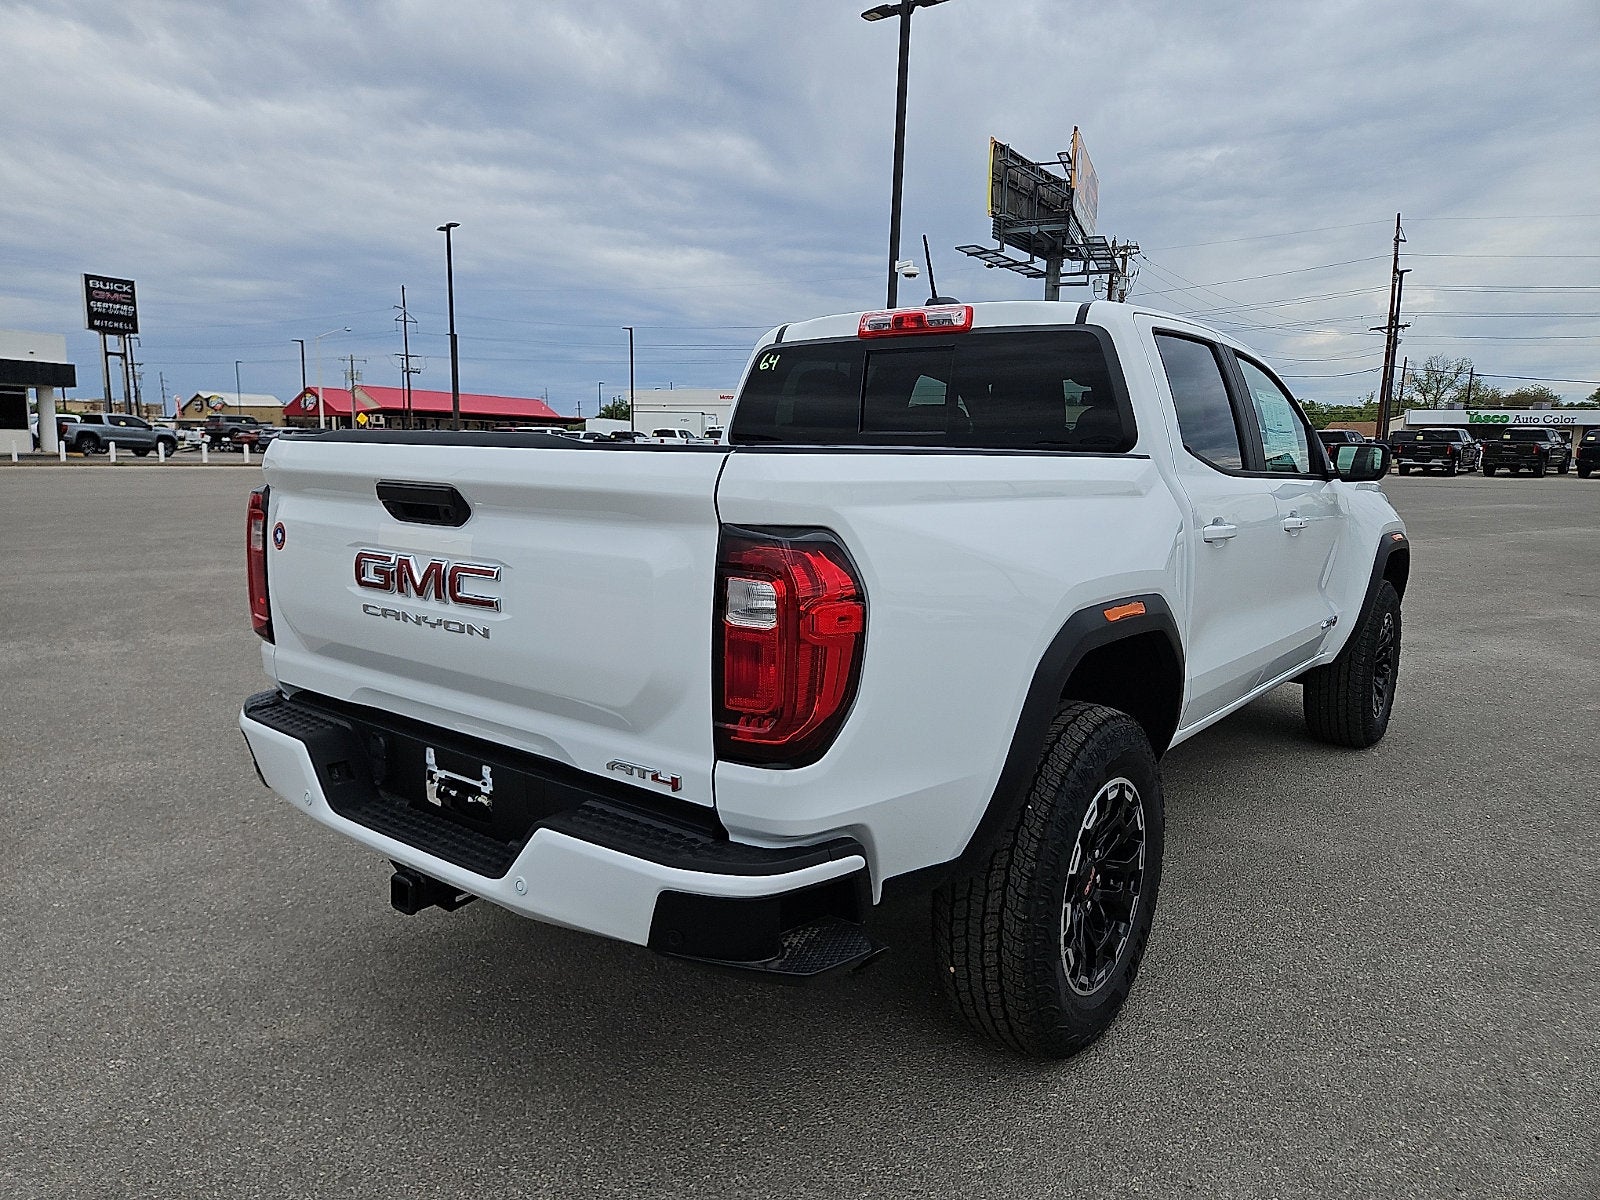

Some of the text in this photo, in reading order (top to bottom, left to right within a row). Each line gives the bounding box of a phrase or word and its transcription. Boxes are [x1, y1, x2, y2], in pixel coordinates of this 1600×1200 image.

[89, 280, 132, 293] BUICK
[94, 320, 133, 330] MITCHELL
[760, 353, 780, 370] 64
[466, 411, 577, 424] TASCO Auto Color
[354, 549, 501, 612] GMC
[362, 603, 490, 639] CANYON
[606, 758, 682, 792] AT4
